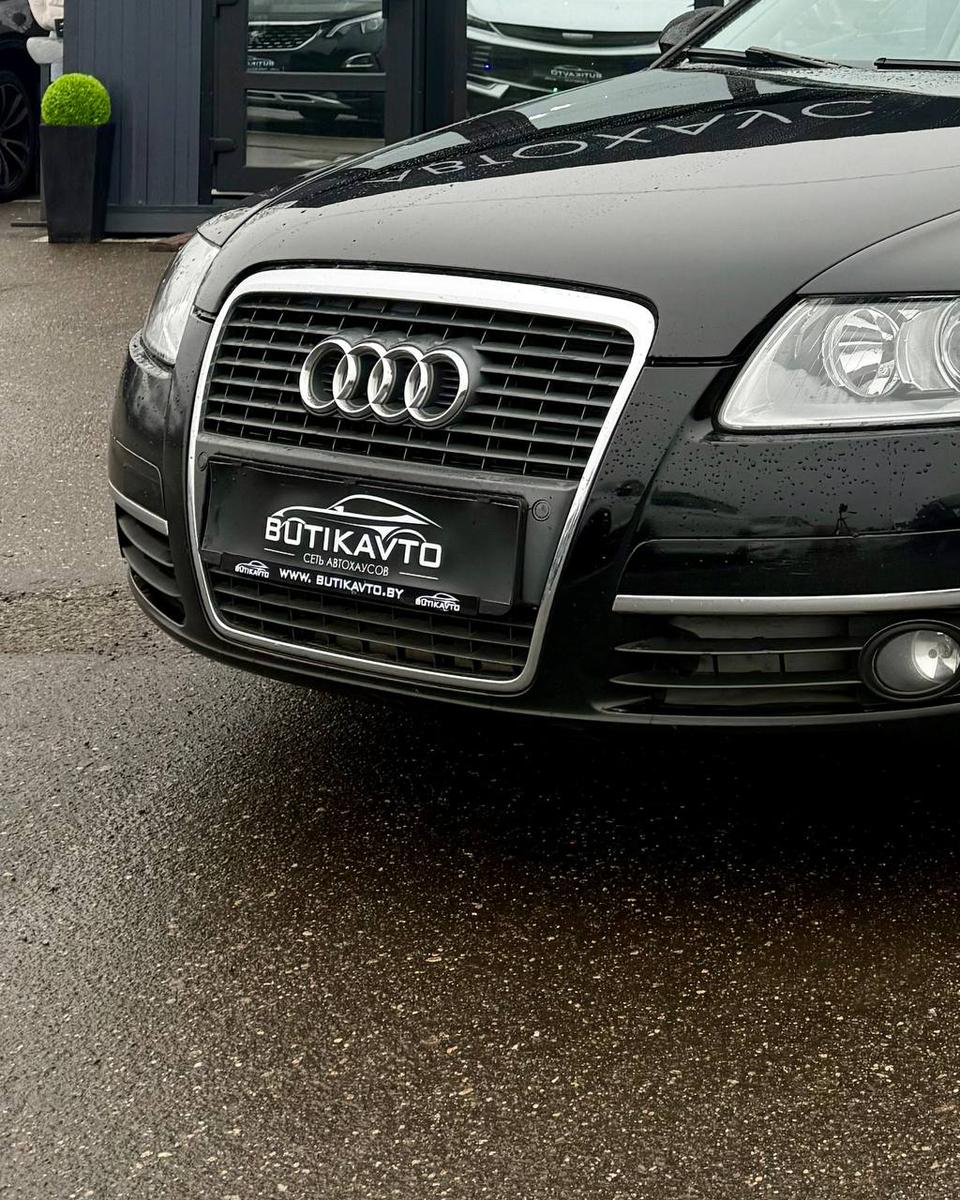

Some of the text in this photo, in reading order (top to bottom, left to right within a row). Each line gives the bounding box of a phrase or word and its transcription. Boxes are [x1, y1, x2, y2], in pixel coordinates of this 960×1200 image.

[264, 516, 442, 568] BUTIKAVTO
[234, 565, 270, 579] BUTIKAVTO
[303, 552, 389, 577] СЕТЬ АВТОХАУСОВ
[279, 567, 404, 600] WWW. BUTIKAVTO.BY
[415, 598, 460, 612] BUTIKAVTO
